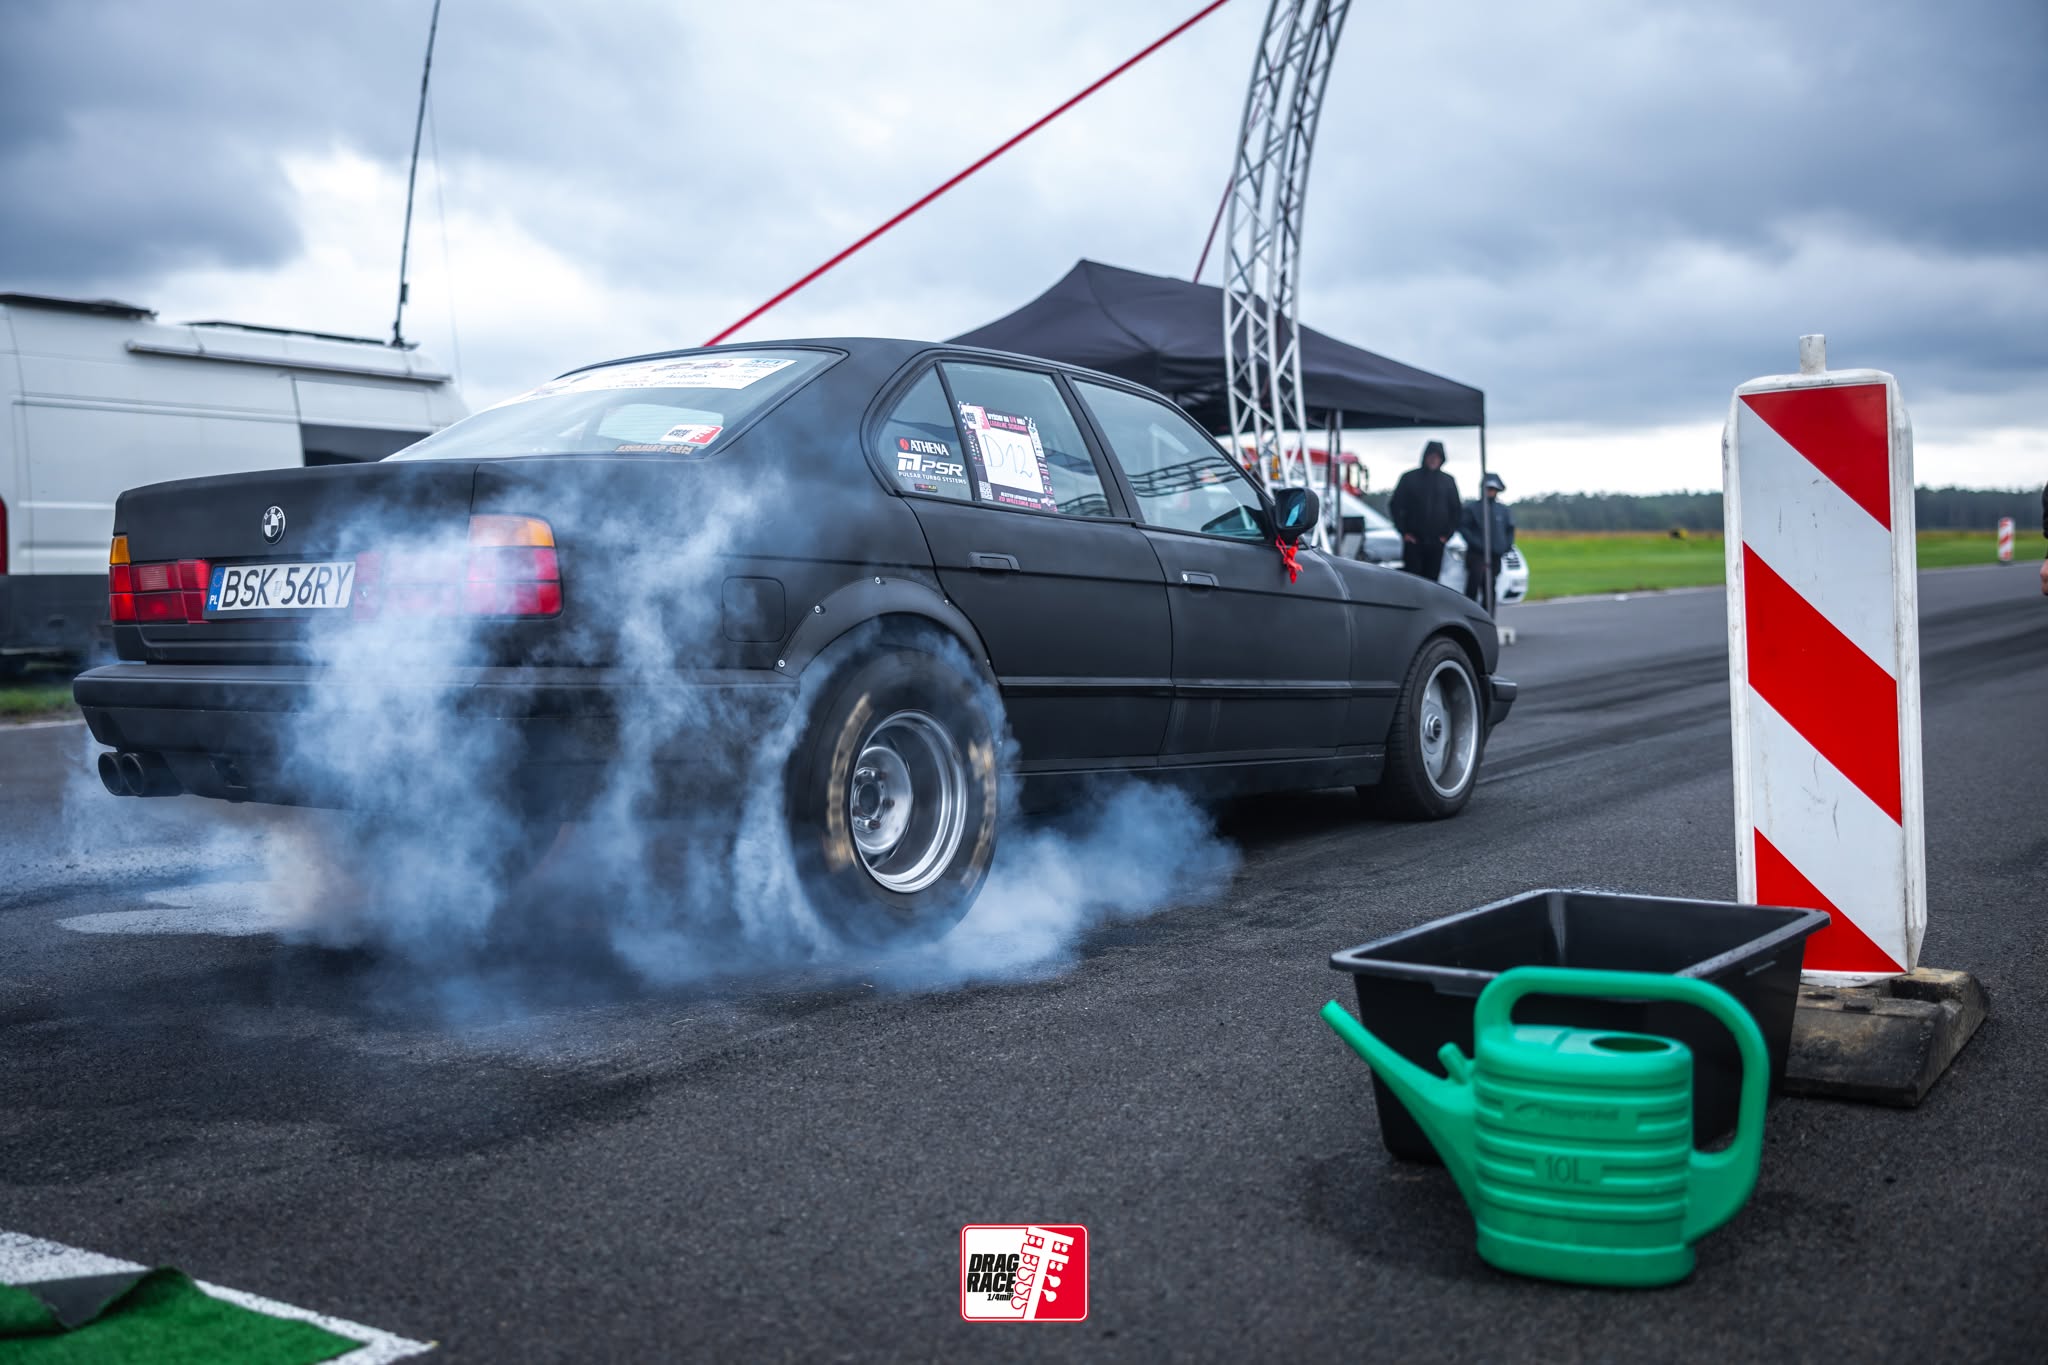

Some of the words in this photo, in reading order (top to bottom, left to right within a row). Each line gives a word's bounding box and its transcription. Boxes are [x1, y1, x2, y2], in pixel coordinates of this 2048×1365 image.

[910, 439, 950, 456] ATHENA
[982, 433, 1033, 479] D12
[922, 459, 964, 477] PSR
[898, 471, 922, 479] PULSAR
[921, 473, 942, 481] TURBO
[942, 476, 967, 485] SYSTEMS
[222, 567, 278, 607] BSK
[281, 564, 354, 605] 56RY
[209, 594, 218, 605] PL
[1545, 1156, 1591, 1184] 10L
